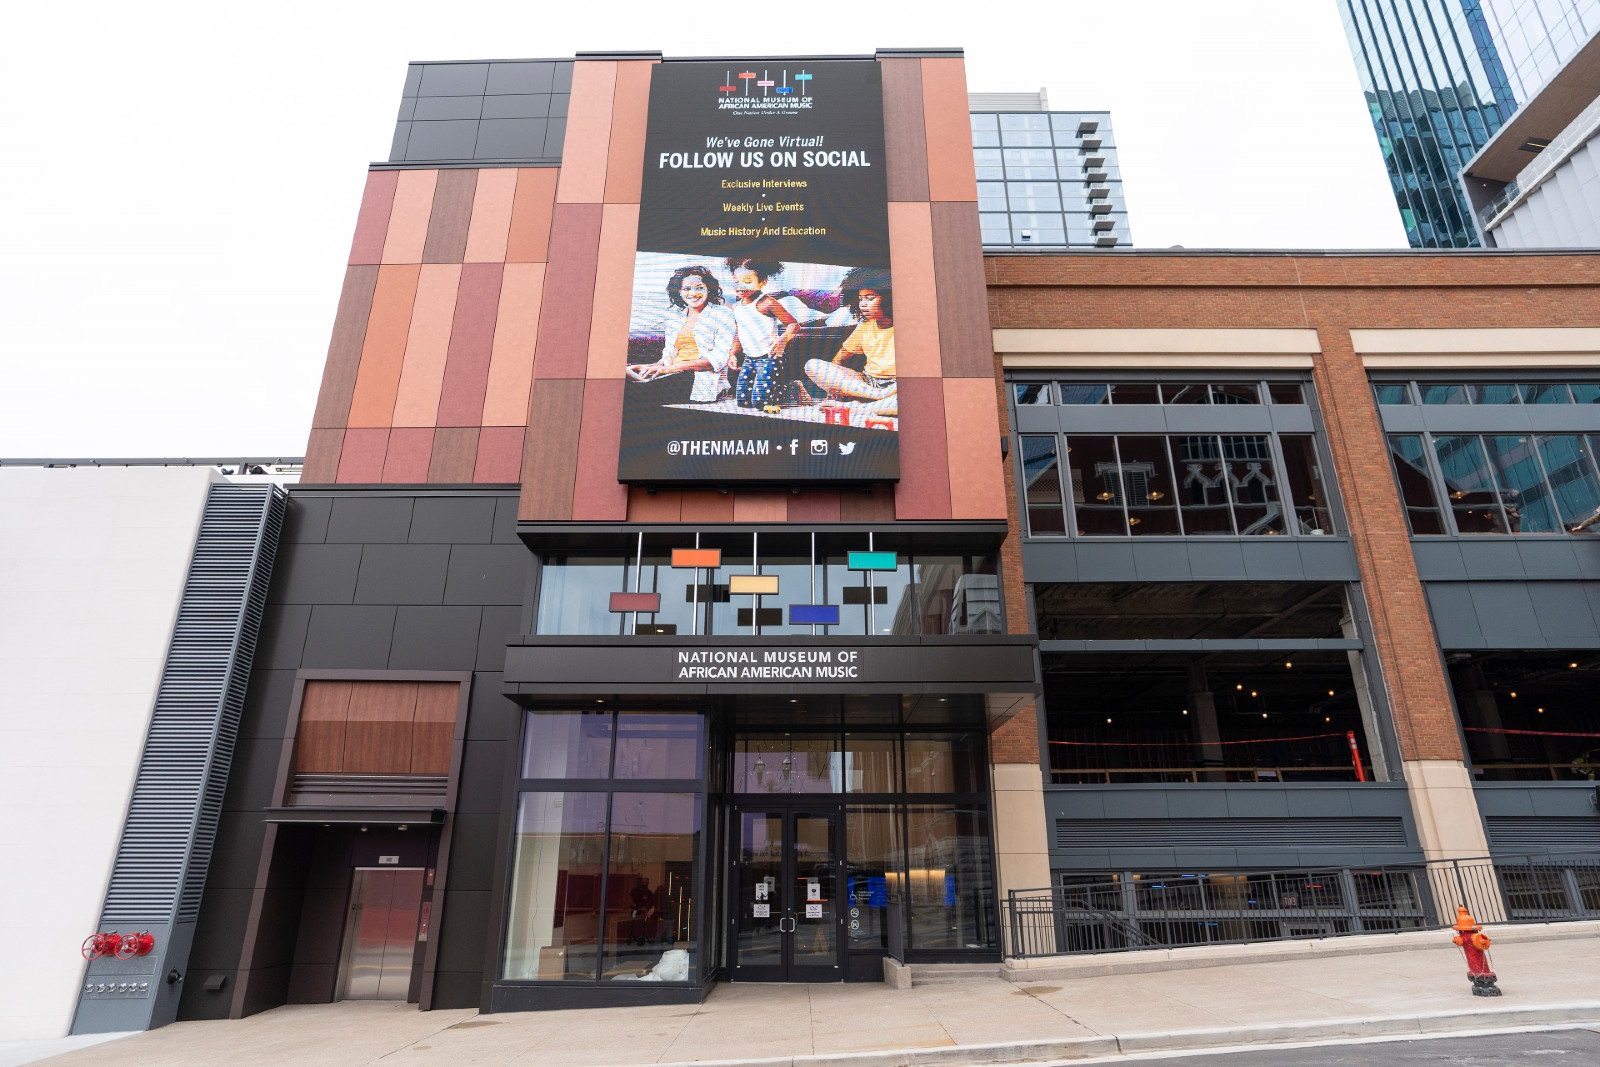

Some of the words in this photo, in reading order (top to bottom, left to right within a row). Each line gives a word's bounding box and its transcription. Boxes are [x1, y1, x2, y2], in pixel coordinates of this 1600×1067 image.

[706, 136, 741, 148] We've
[744, 136, 775, 148] Gone
[779, 136, 824, 148] Virtual!
[659, 152, 734, 169] FOLLOW
[740, 152, 764, 168] US
[770, 152, 797, 168] ON
[803, 150, 871, 167] SOCIAL
[722, 180, 761, 189] Exclusive
[762, 179, 808, 188] Interviews
[722, 203, 754, 214] Weekly
[756, 203, 774, 212] Live
[776, 202, 805, 212] Events
[700, 228, 727, 236] Music
[728, 227, 761, 238] History
[762, 226, 780, 236] And
[782, 226, 826, 236] Education
[666, 440, 769, 456] @THENMAAM
[678, 652, 758, 663] NATIONAL
[764, 652, 831, 663] MUSEUM
[838, 651, 858, 663] OF
[678, 666, 738, 678] AFRICAN
[740, 666, 812, 678] AMERICAN
[816, 666, 858, 678] MUSIC
